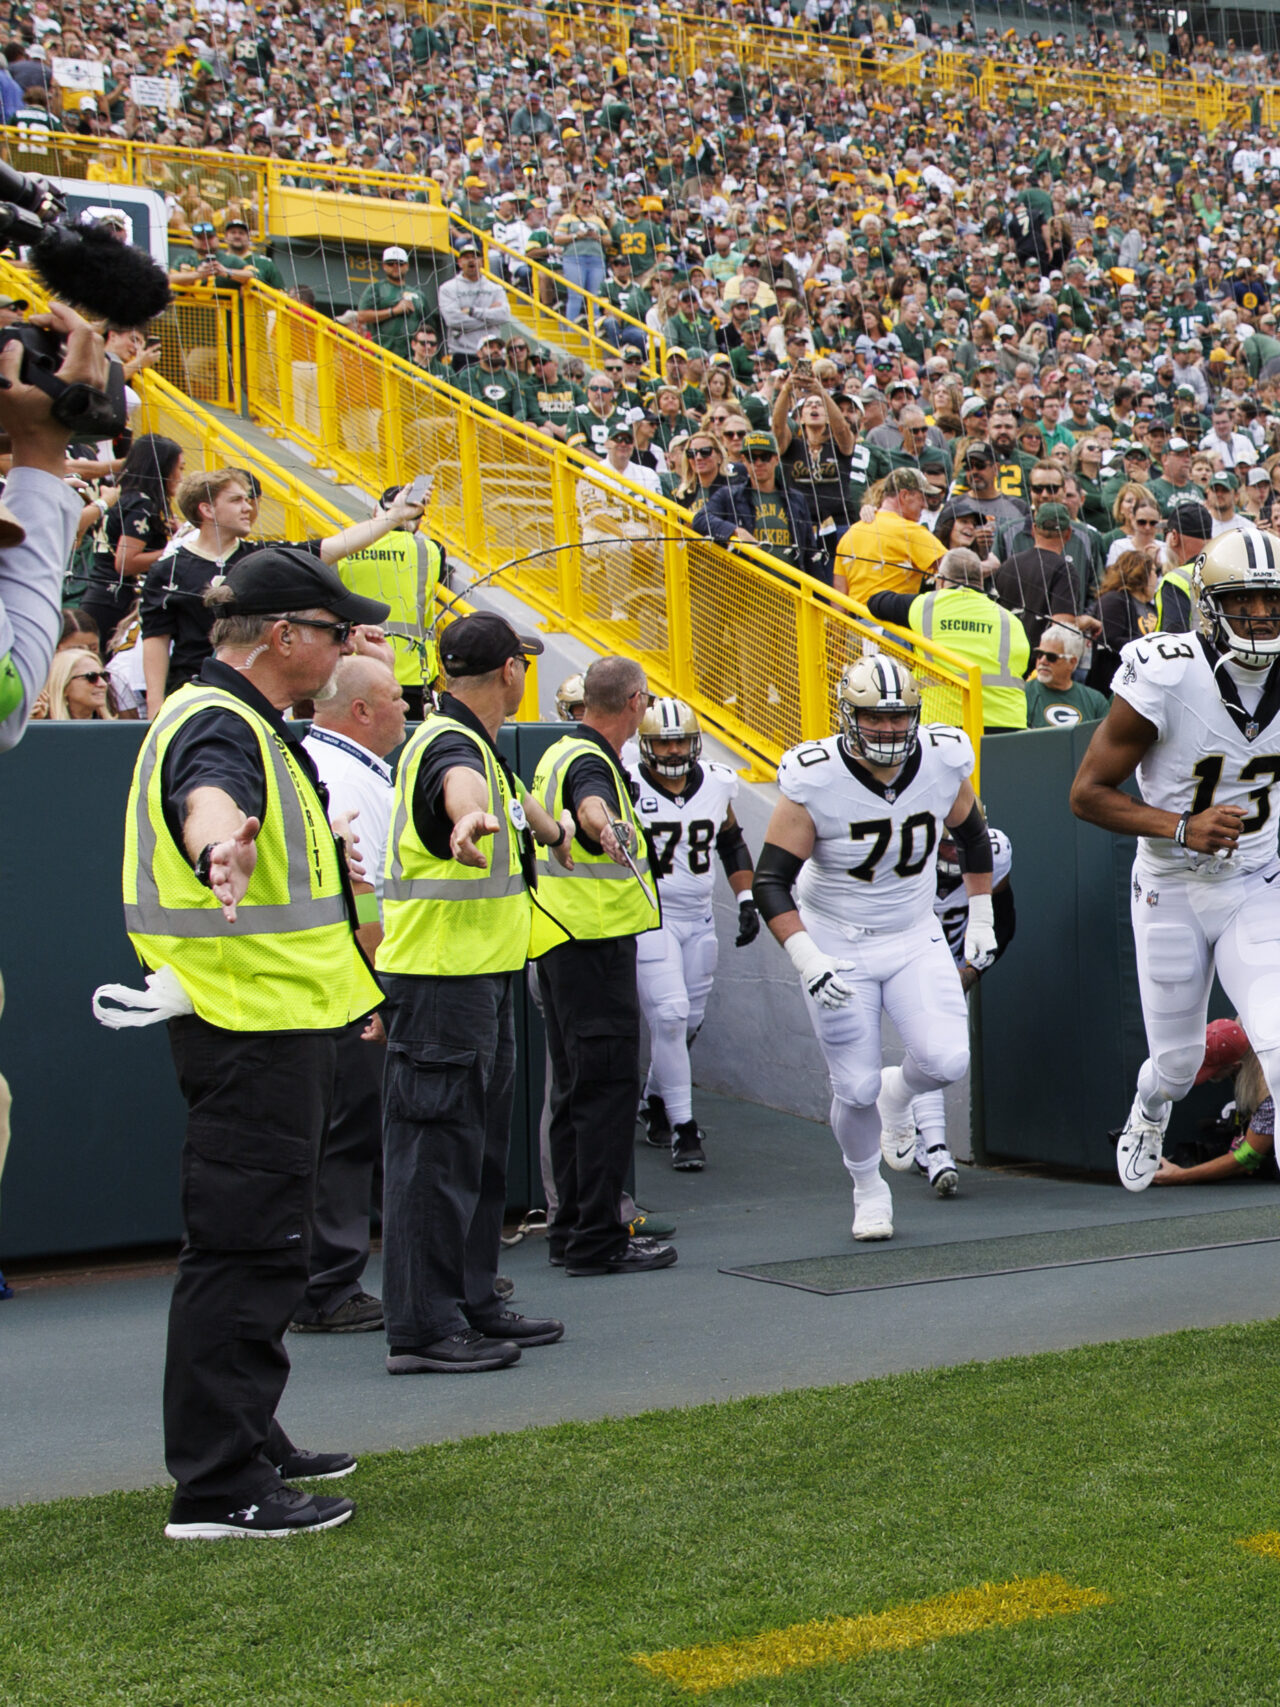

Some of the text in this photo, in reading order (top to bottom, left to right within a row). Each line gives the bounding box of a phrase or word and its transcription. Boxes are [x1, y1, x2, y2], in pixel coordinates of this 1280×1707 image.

[620, 232, 648, 255] 23
[346, 549, 406, 562] SECURITY
[939, 618, 994, 635] SECURITY
[272, 732, 322, 888] SECURITY
[650, 819, 716, 875] 78
[848, 810, 937, 883] 70
